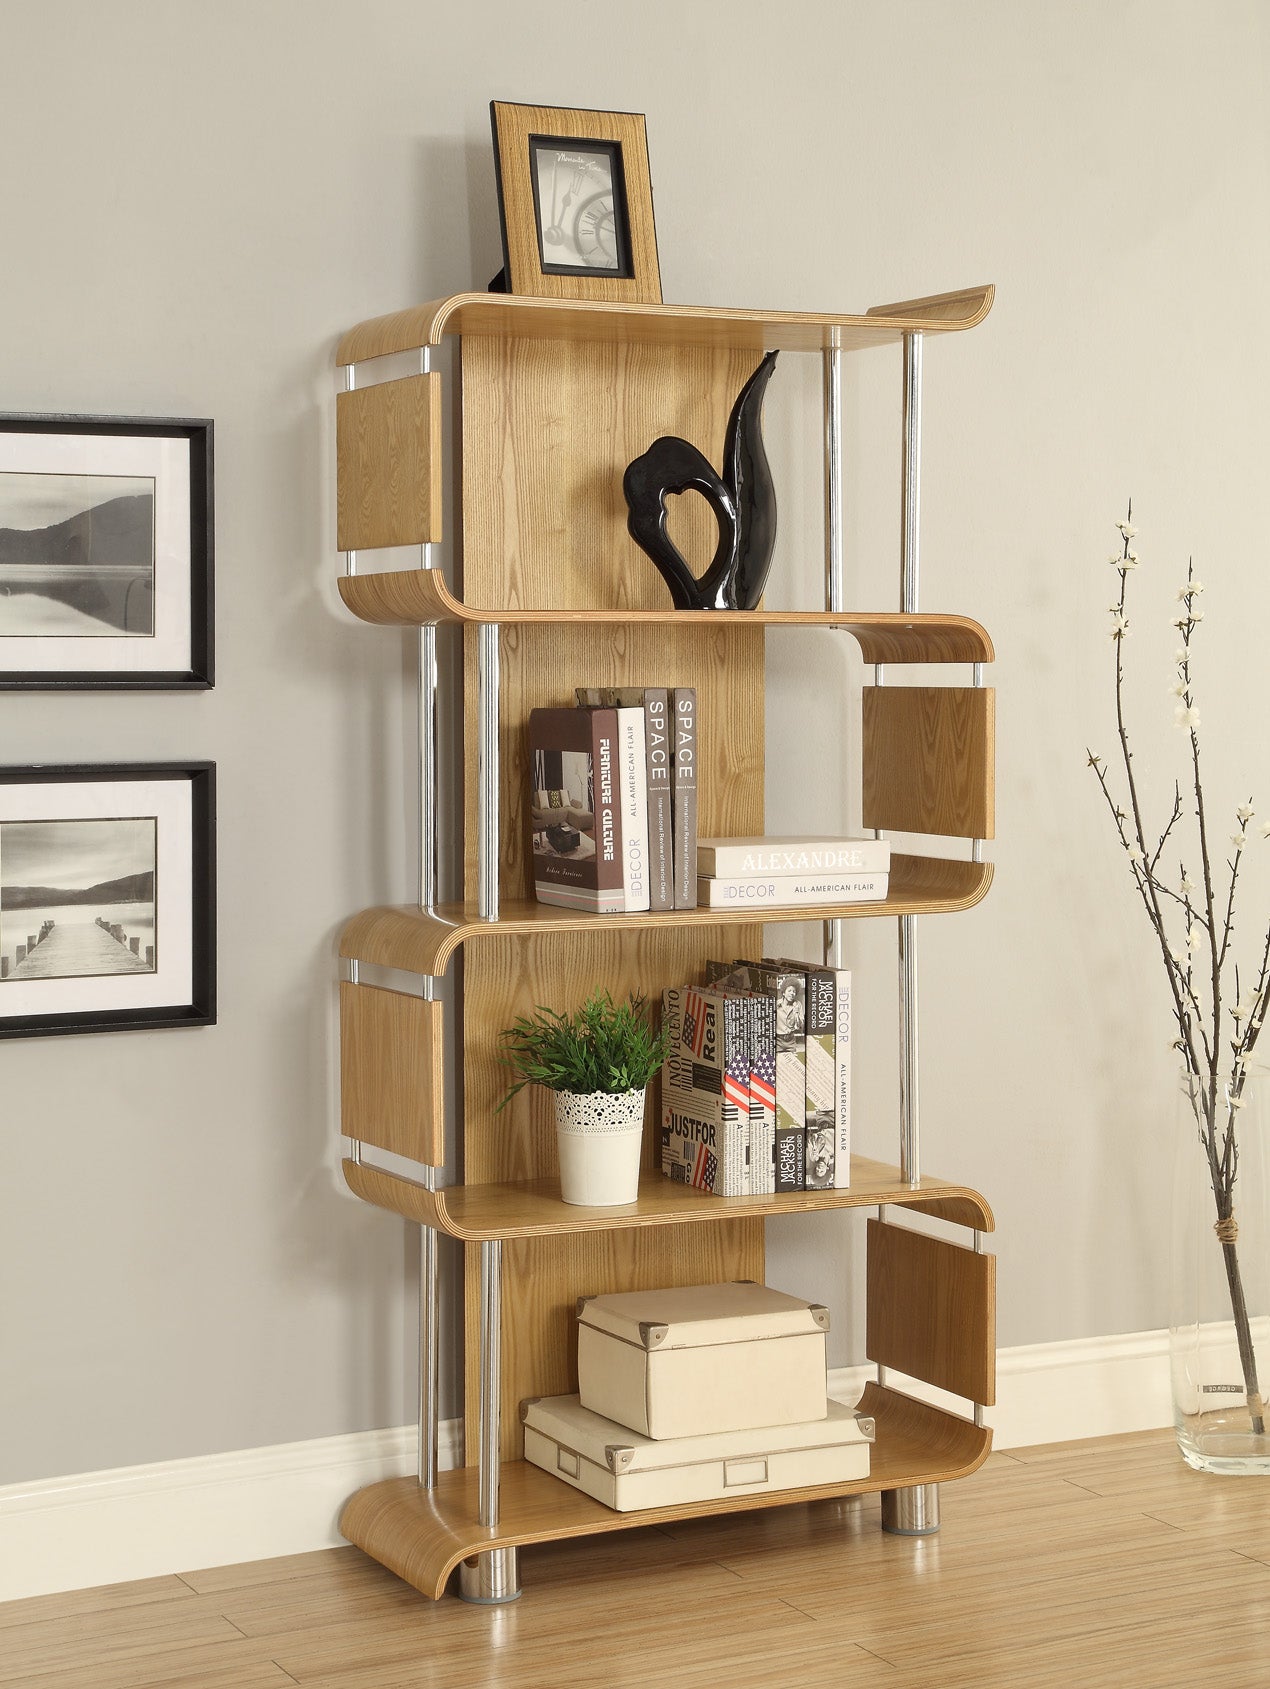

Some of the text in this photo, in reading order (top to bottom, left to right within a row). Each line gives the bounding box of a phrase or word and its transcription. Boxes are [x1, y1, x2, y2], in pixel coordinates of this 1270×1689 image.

[650, 701, 666, 780] SPACE
[678, 700, 693, 778] SPACE
[628, 752, 637, 817] ALL-AMERICAN
[602, 808, 614, 861] CULTURE
[629, 839, 643, 891] DECOR
[742, 850, 864, 871] ALEXANDRE
[660, 881, 668, 902] Design
[729, 884, 775, 899] DECOR
[794, 884, 851, 893] ALL-AMERICAN
[854, 883, 874, 891] FLAIR
[818, 979, 827, 1028] JACKSON
[825, 980, 833, 1024] MICHAEL
[838, 992, 849, 1043] DECOR
[703, 1002, 715, 1062] Real
[667, 1112, 716, 1148] JUSTFOR
[780, 1139, 788, 1183] MICHAEL
[786, 1135, 795, 1184] JACKSON
